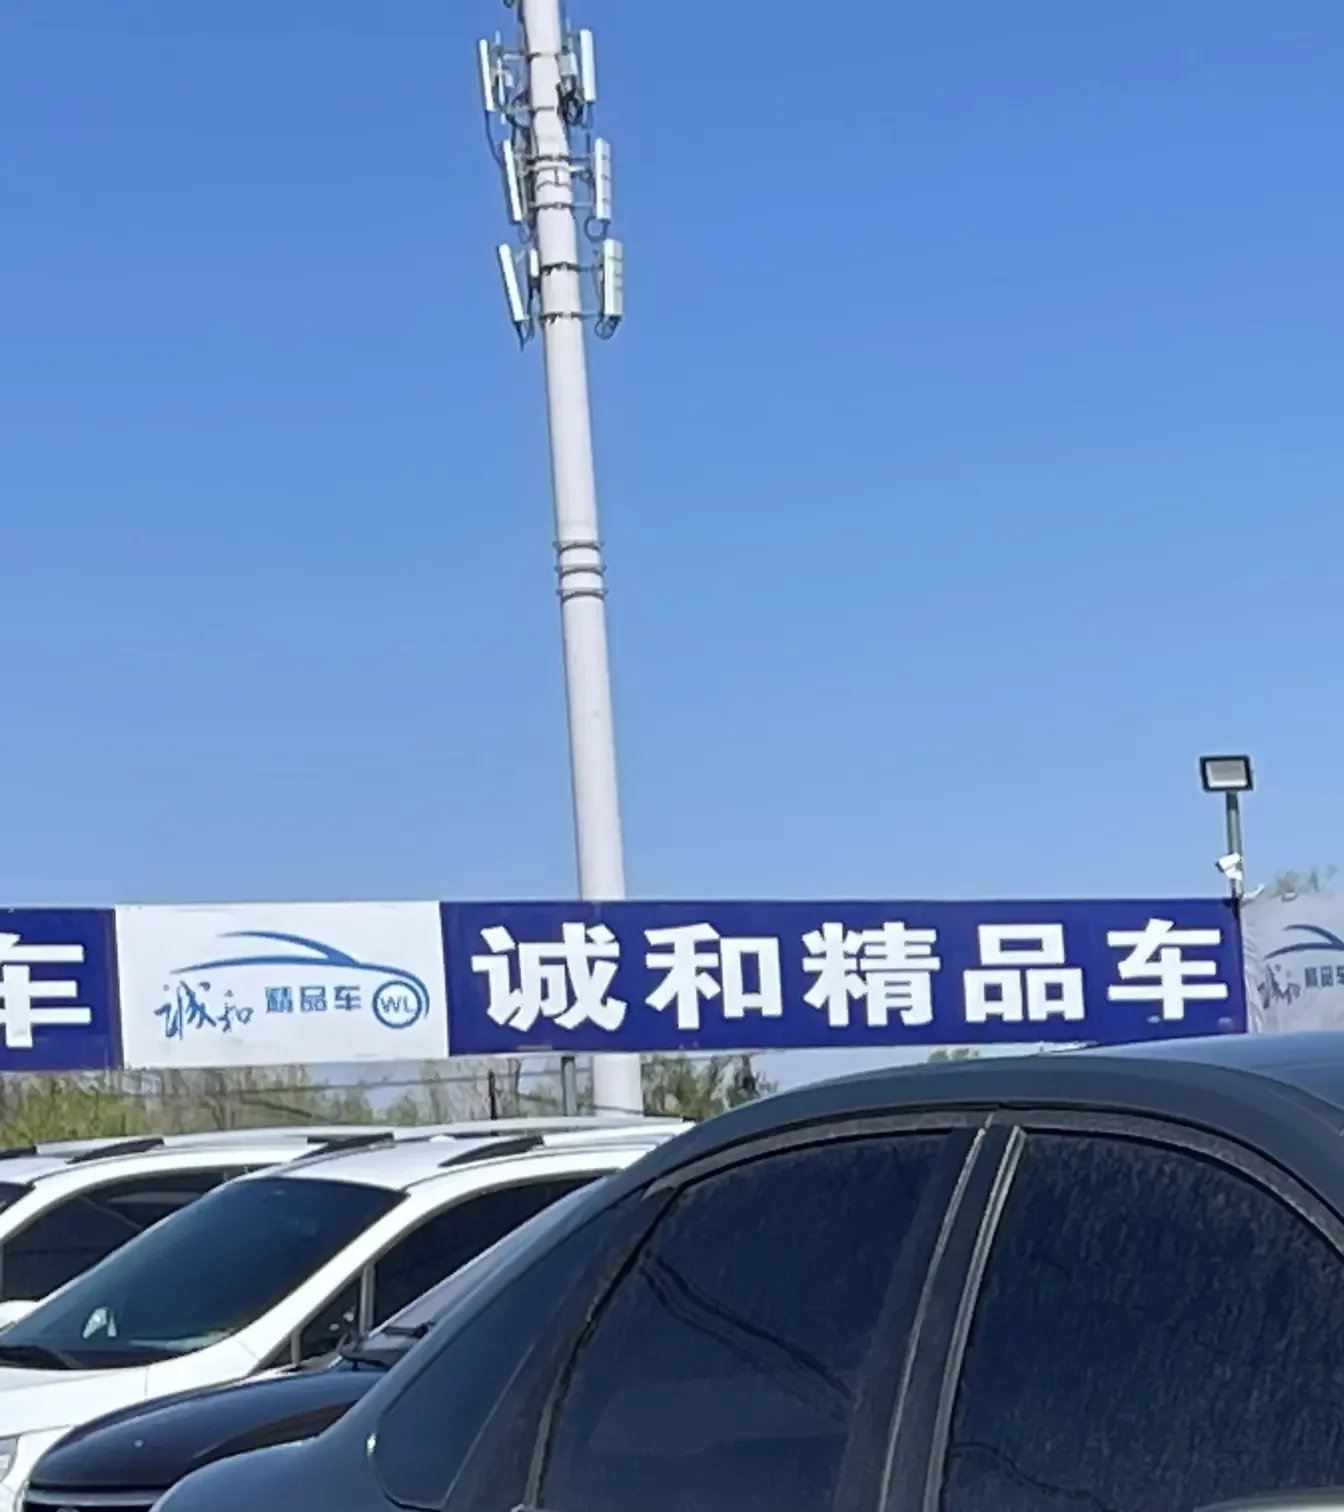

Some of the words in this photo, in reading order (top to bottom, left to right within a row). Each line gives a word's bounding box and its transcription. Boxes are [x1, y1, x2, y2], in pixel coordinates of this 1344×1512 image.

[0, 932, 92, 1048] 车
[472, 919, 1229, 1032] 诚和精品车
